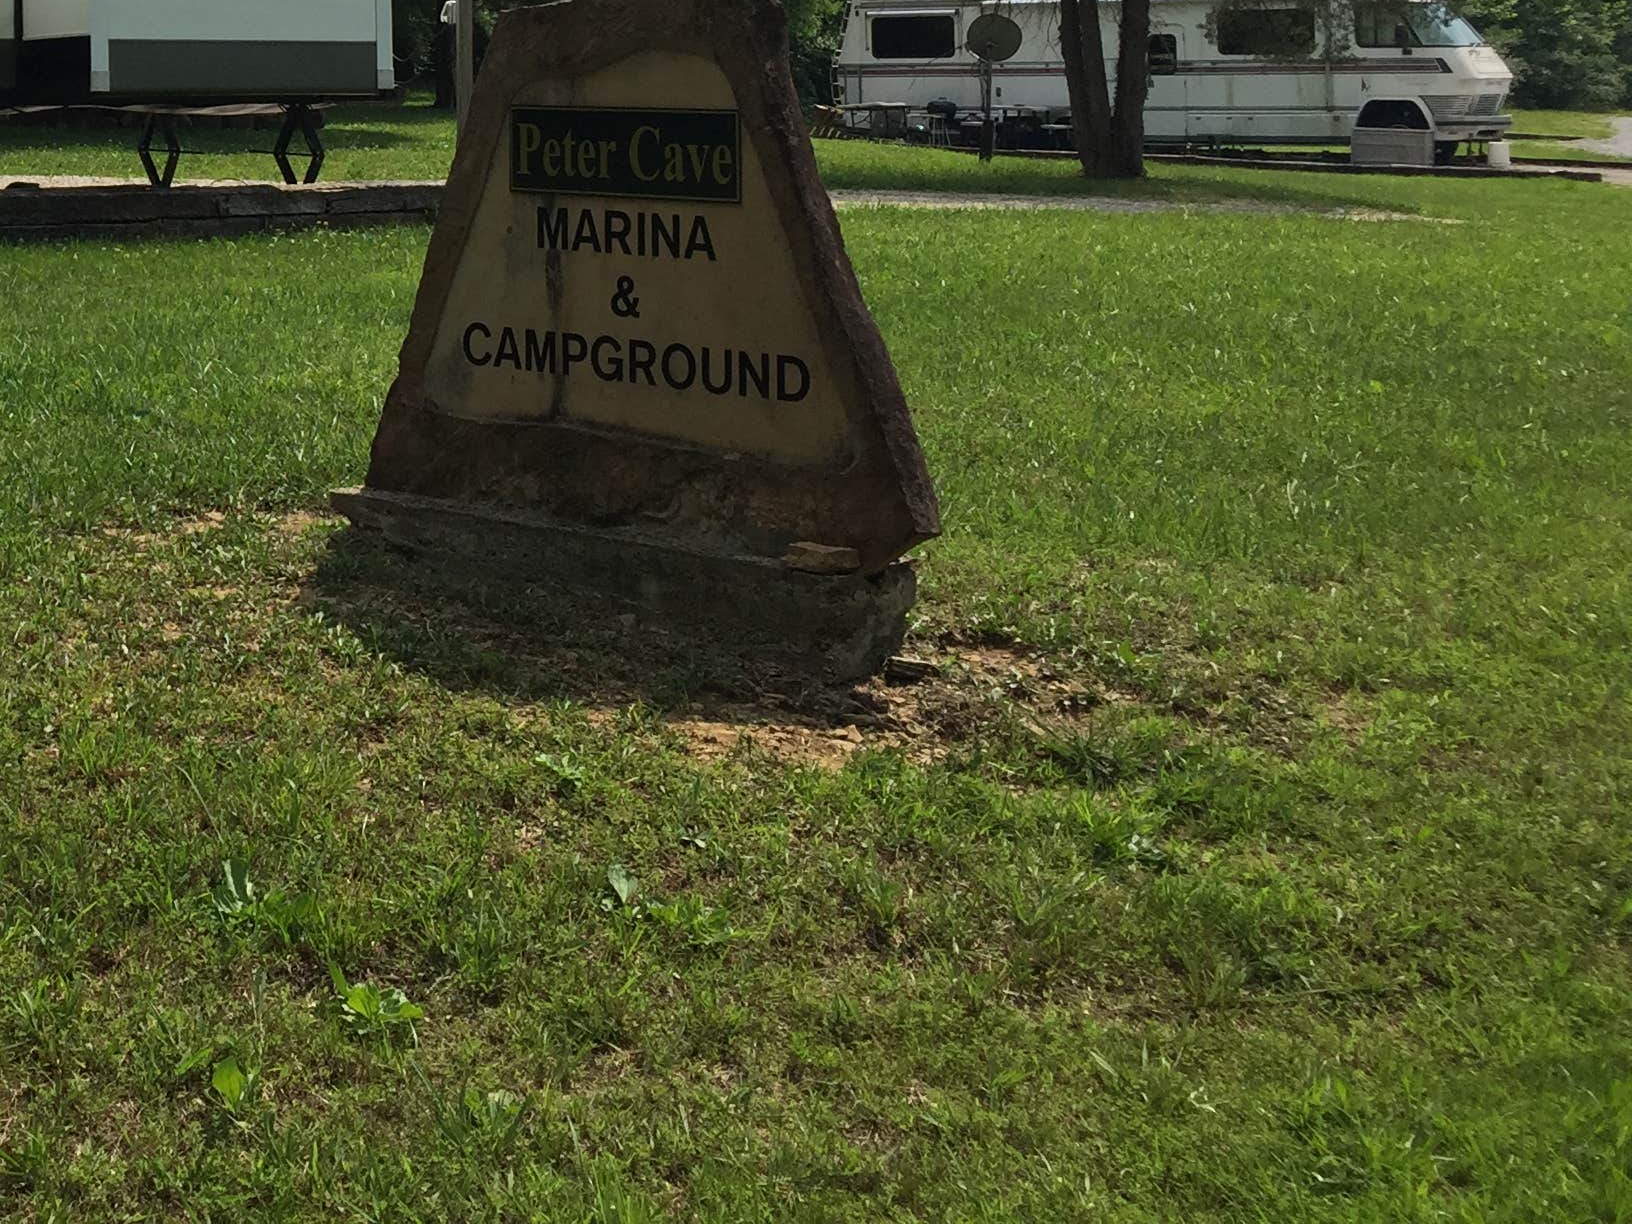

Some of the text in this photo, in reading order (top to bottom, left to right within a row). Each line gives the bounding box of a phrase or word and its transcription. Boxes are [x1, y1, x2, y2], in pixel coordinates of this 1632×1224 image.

[516, 122, 733, 185] Peter Cave
[536, 206, 717, 261] MARINA
[611, 275, 640, 318] &
[462, 322, 811, 402] CAMPGROUND
